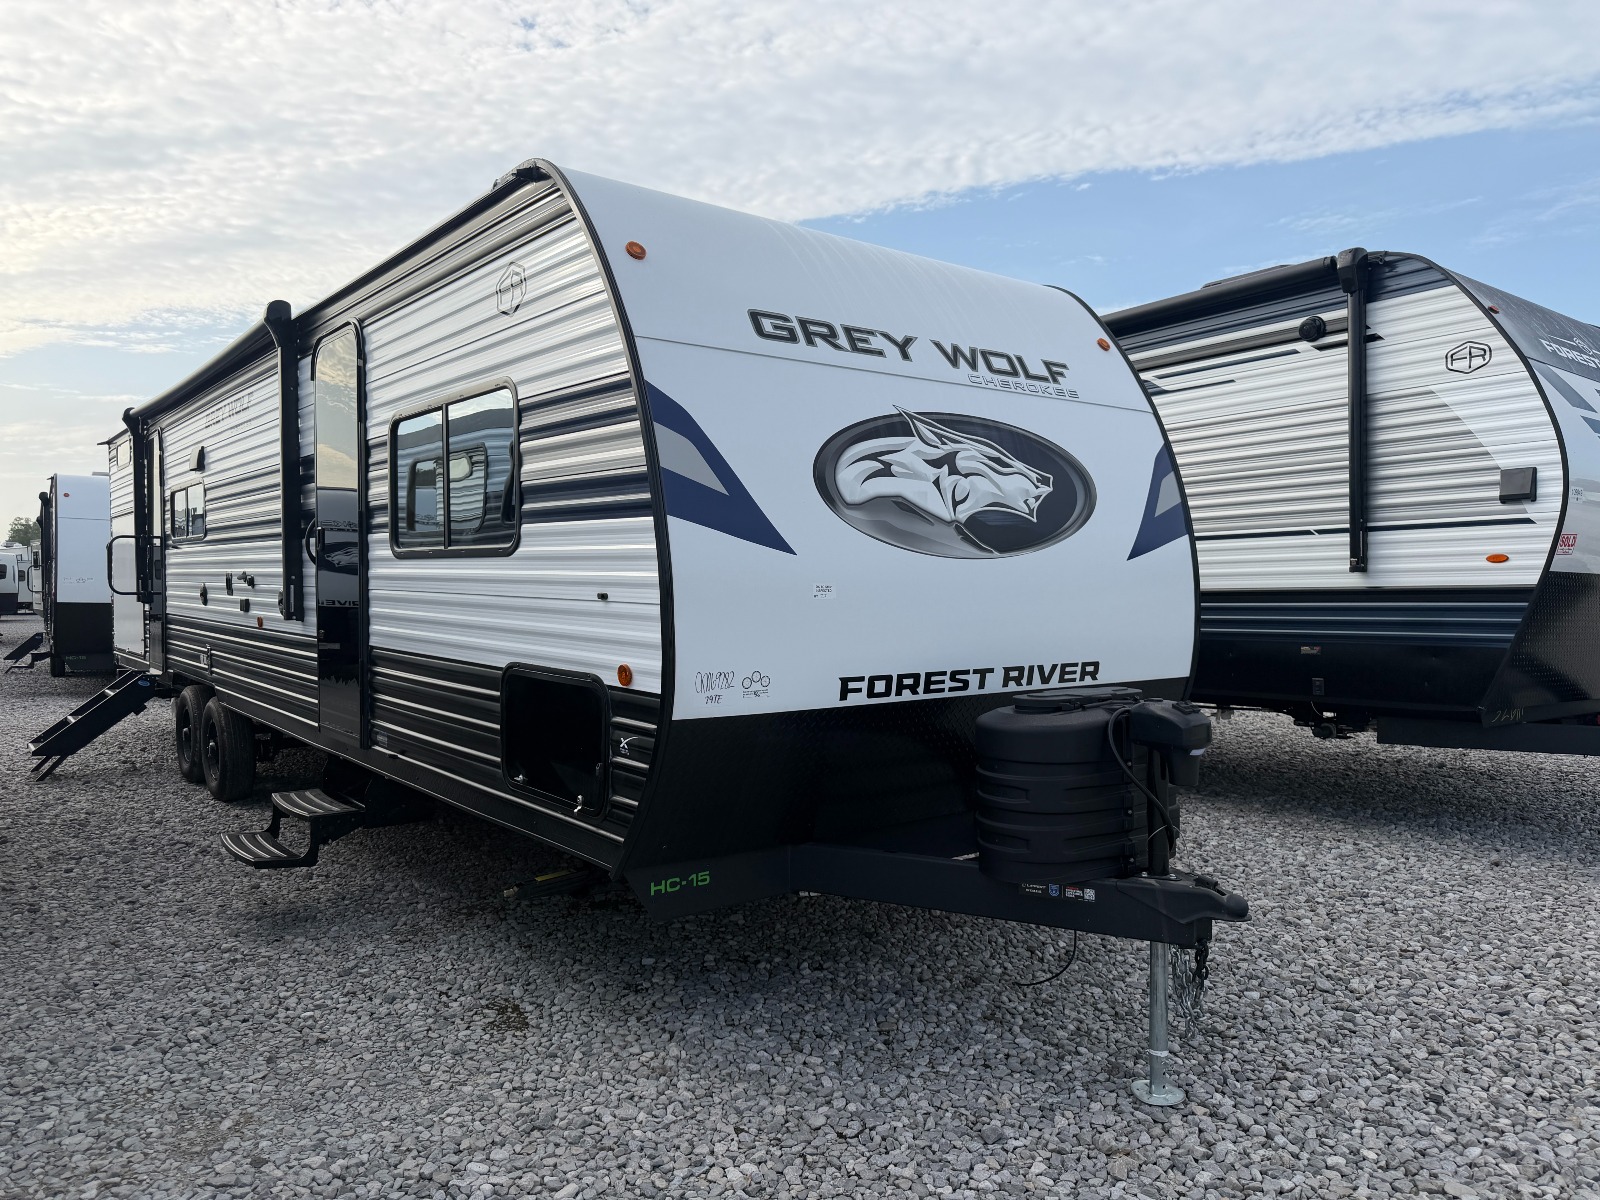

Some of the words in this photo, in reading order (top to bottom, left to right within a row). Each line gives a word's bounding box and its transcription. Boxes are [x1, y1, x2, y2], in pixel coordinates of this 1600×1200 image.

[747, 308, 918, 362] GREY
[929, 338, 1069, 385] WOLF
[967, 373, 1080, 399] CHEROKEE
[838, 668, 994, 701] FOREST
[1001, 661, 1100, 688] RIVER
[650, 870, 710, 896] HC-15
